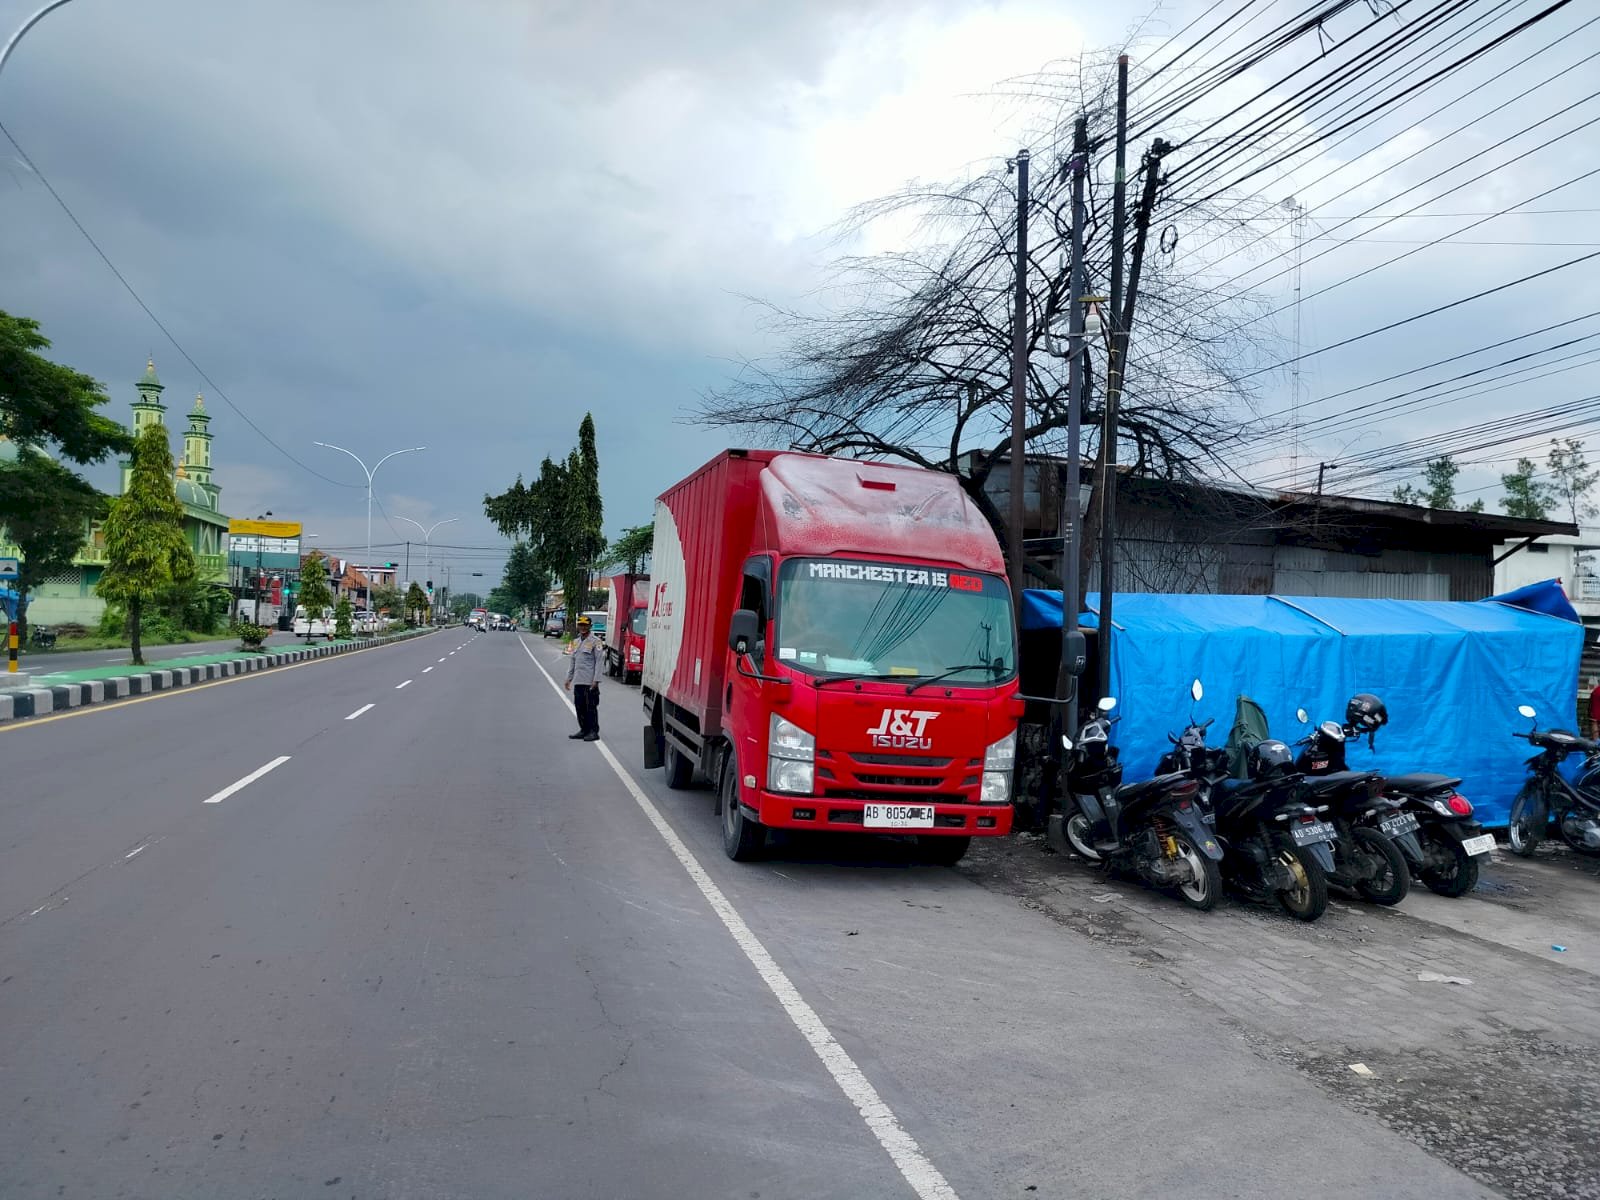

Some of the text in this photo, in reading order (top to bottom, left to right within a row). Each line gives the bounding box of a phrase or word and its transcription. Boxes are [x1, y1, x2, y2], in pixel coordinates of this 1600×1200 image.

[809, 563, 983, 592] MANCHESTER IS RED
[866, 708, 942, 737] J&T
[872, 734, 932, 750] ISUZU
[866, 805, 933, 820] AB 8054 EA
[1294, 829, 1305, 838] AD
